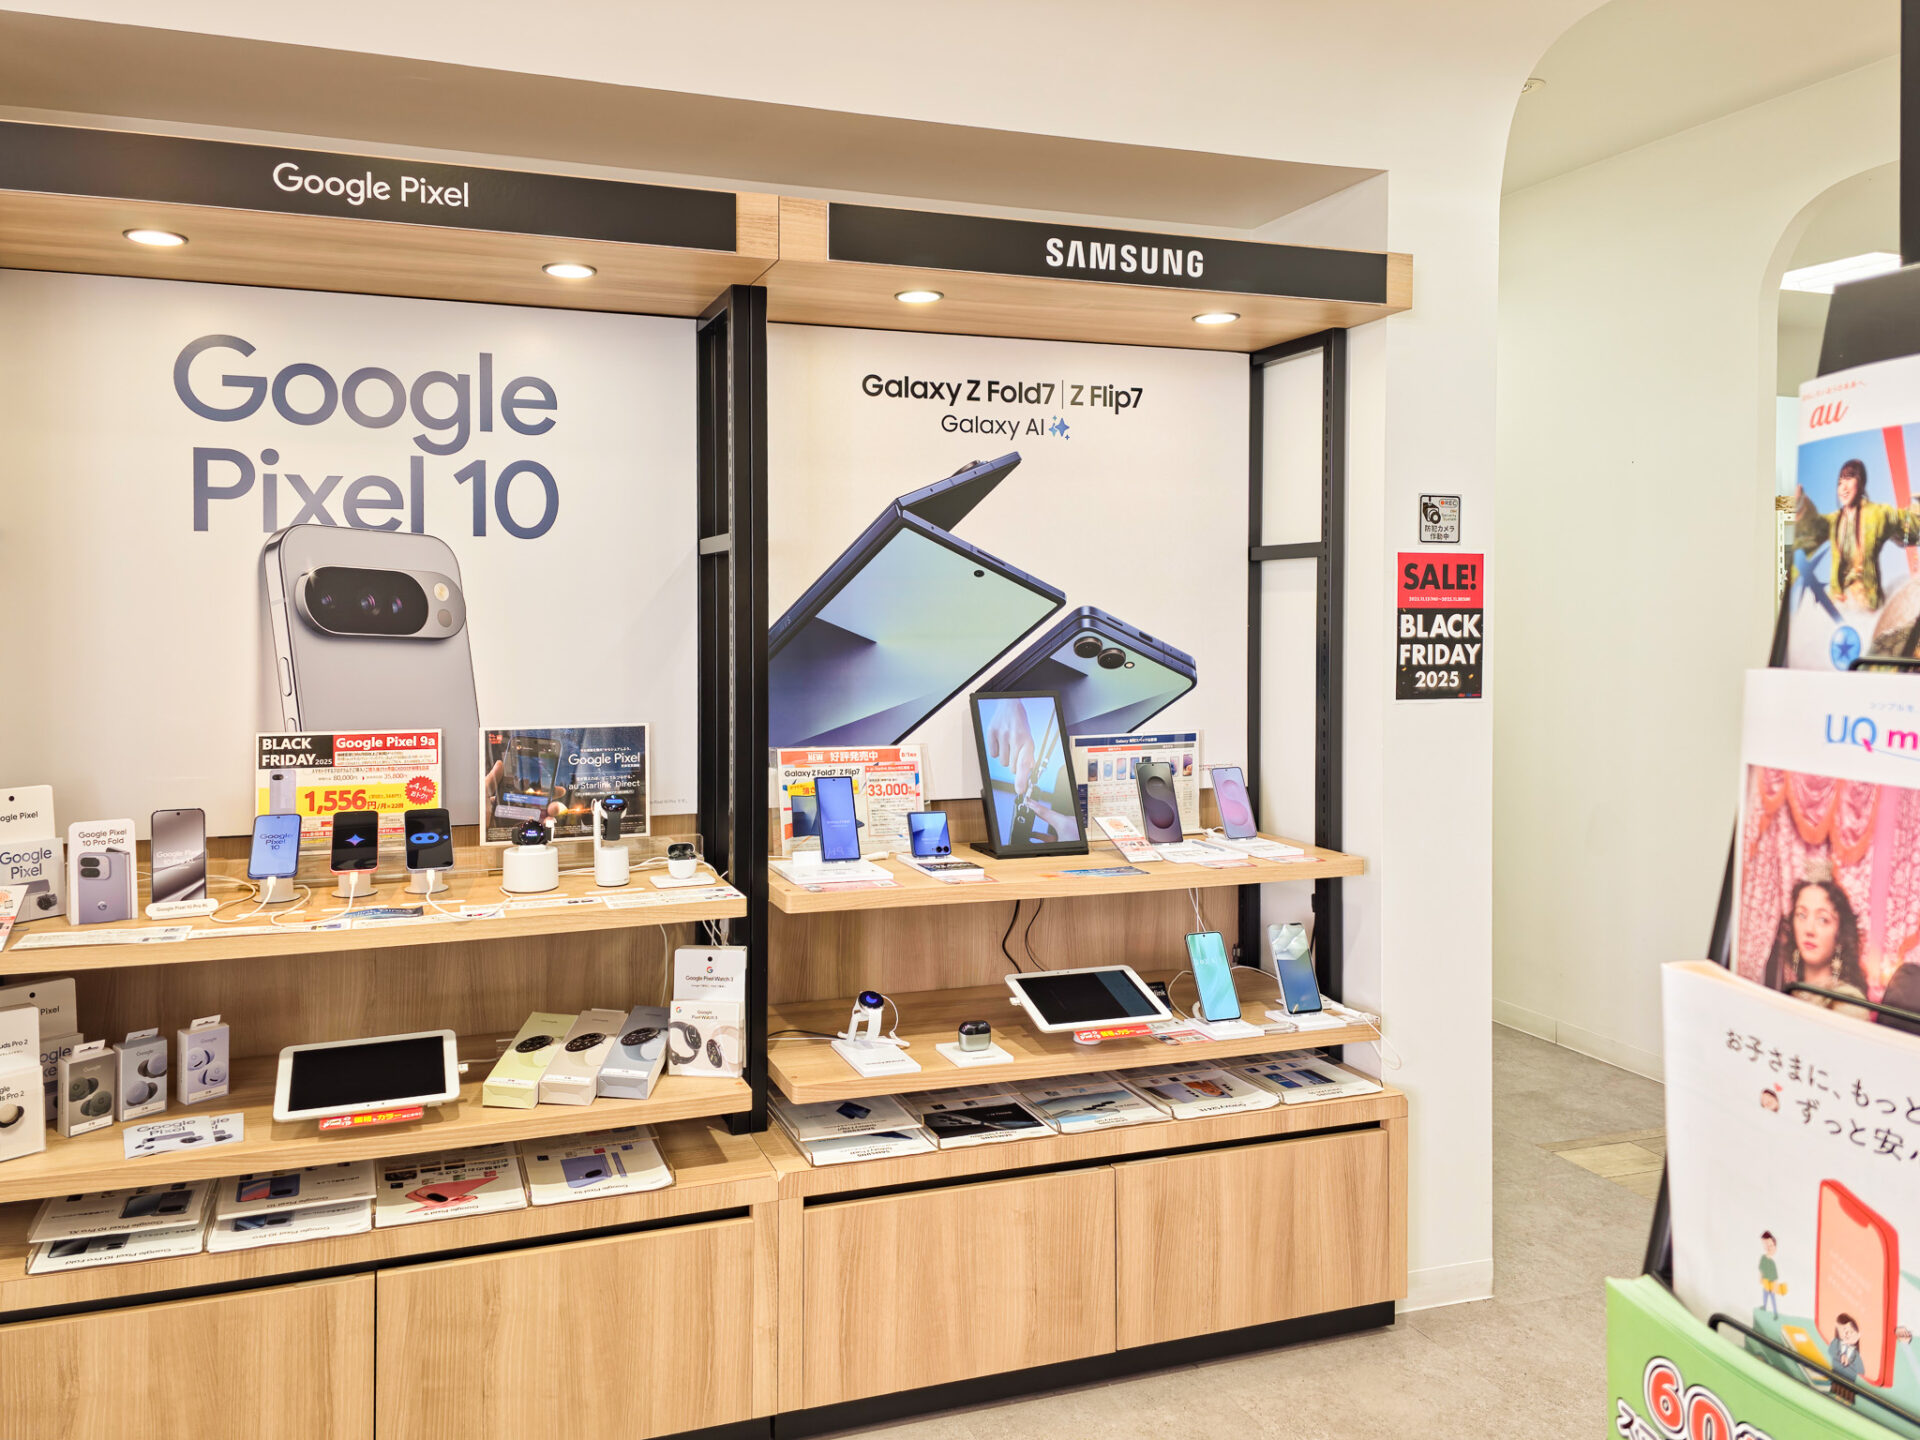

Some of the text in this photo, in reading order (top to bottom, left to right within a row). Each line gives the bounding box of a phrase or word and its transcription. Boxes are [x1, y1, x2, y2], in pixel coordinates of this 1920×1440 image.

[272, 162, 469, 208] Google Pixel
[1045, 237, 1204, 279] SAMSUNG
[173, 334, 558, 456] Google
[862, 374, 1143, 415] Galaxy Z Fold7 Z Flip7
[1809, 400, 1848, 429] au
[941, 414, 1045, 441] Galaxy AI
[193, 446, 560, 540] Pixel 10
[1424, 524, 1455, 533] 防犯カメラ
[1430, 532, 1449, 540] 作動中
[1403, 562, 1477, 590] SALE!
[1400, 613, 1481, 638] BLACK
[1400, 643, 1481, 666] FRIDAY
[1414, 670, 1460, 688] 2025
[1825, 713, 1877, 753] UQ
[262, 738, 312, 750] BLACK
[336, 735, 436, 750] Google Pixel 9a
[262, 754, 316, 767] FRIDAY
[315, 758, 333, 766] 2025
[568, 752, 640, 767] Google Pixel
[807, 752, 824, 761] NEW
[784, 769, 811, 777] Galaxy
[817, 768, 836, 776] Fold7
[845, 768, 860, 777] Flip7
[580, 780, 612, 790] Starlink
[615, 779, 641, 788] Direct
[868, 783, 909, 797] 33,000
[19, 811, 38, 820] Pixel
[78, 830, 108, 838] Google
[0, 847, 52, 865] Google
[11, 863, 42, 879] Pixel
[40, 1006, 60, 1015] Pixel
[40, 1046, 72, 1064] ogle
[1726, 1029, 1920, 1125] お子さまに、もっと
[136, 1120, 196, 1132] Google
[150, 1126, 185, 1136] Pixel
[1795, 1098, 1920, 1162] ずっと安
[138, 1248, 172, 1256] Google
